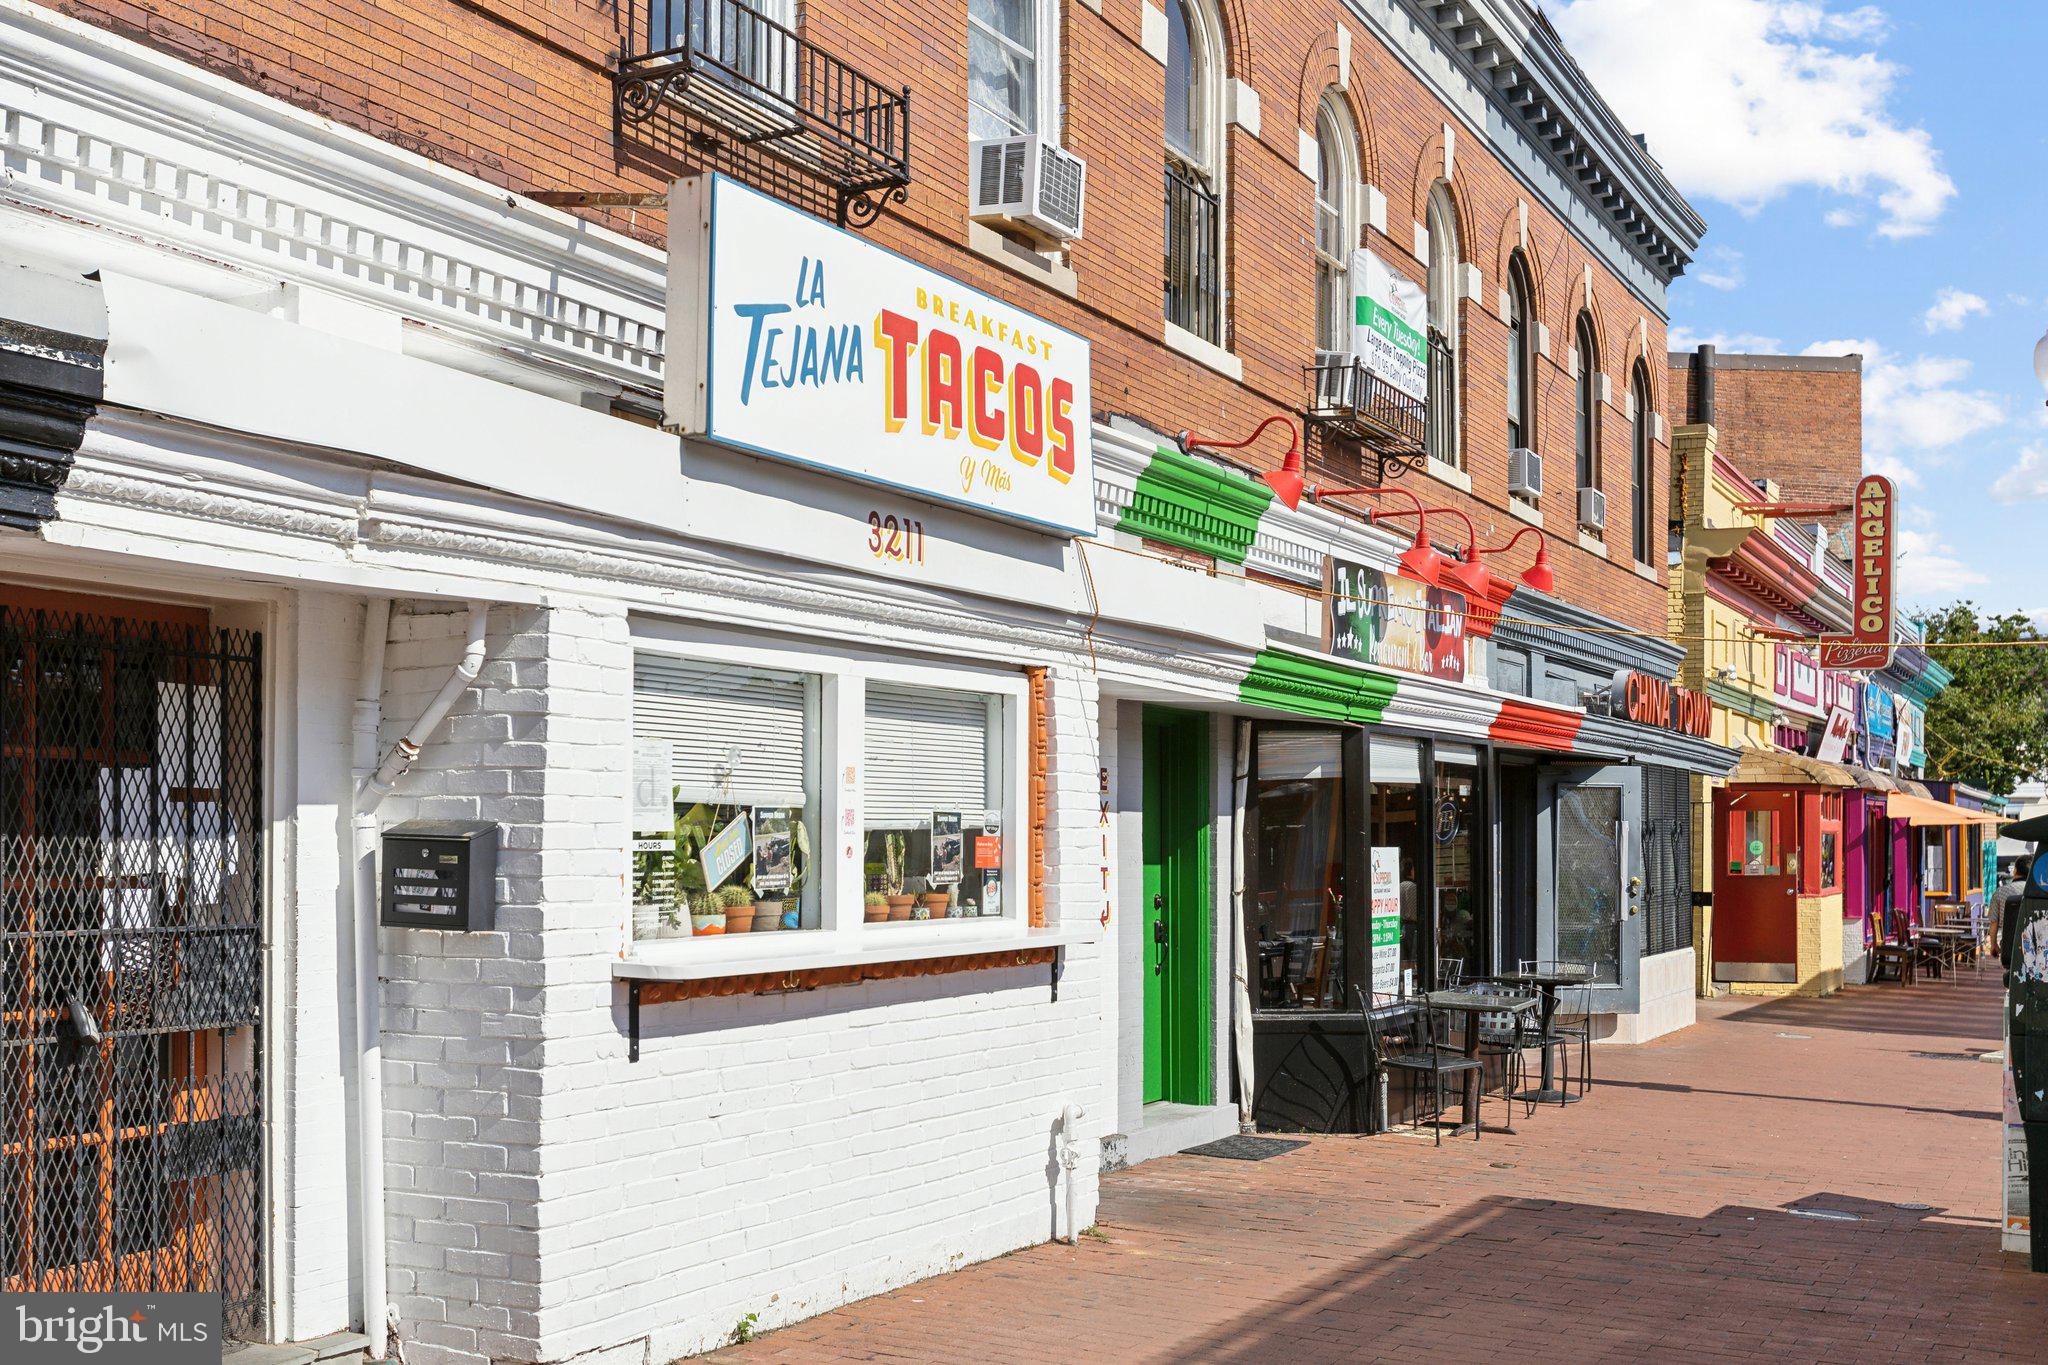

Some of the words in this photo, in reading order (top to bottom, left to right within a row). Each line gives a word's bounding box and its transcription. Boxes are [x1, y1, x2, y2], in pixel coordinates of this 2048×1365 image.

[795, 255, 825, 309] LA
[915, 286, 1053, 361] BREAKFAST
[1372, 306, 1393, 339] Every
[1393, 320, 1421, 357] Tuesday!
[734, 303, 864, 407] TEJANA
[1367, 328, 1382, 352] Large
[1393, 346, 1412, 374] Topping
[1413, 360, 1426, 380] Pizza
[1390, 363, 1402, 387] Carry
[873, 307, 1076, 486] TACOS
[980, 458, 1012, 493] Más
[867, 510, 925, 567] 3211
[1859, 480, 1887, 634] ANGELICO
[1824, 639, 1884, 662] Pizzeria
[1625, 670, 1671, 729] CHINA
[1674, 685, 1713, 739] TOWN
[638, 841, 662, 850] HOURS
[715, 837, 743, 876] CLOSED
[1100, 767, 1110, 893] EXIT
[1384, 897, 1398, 914] HOUR
